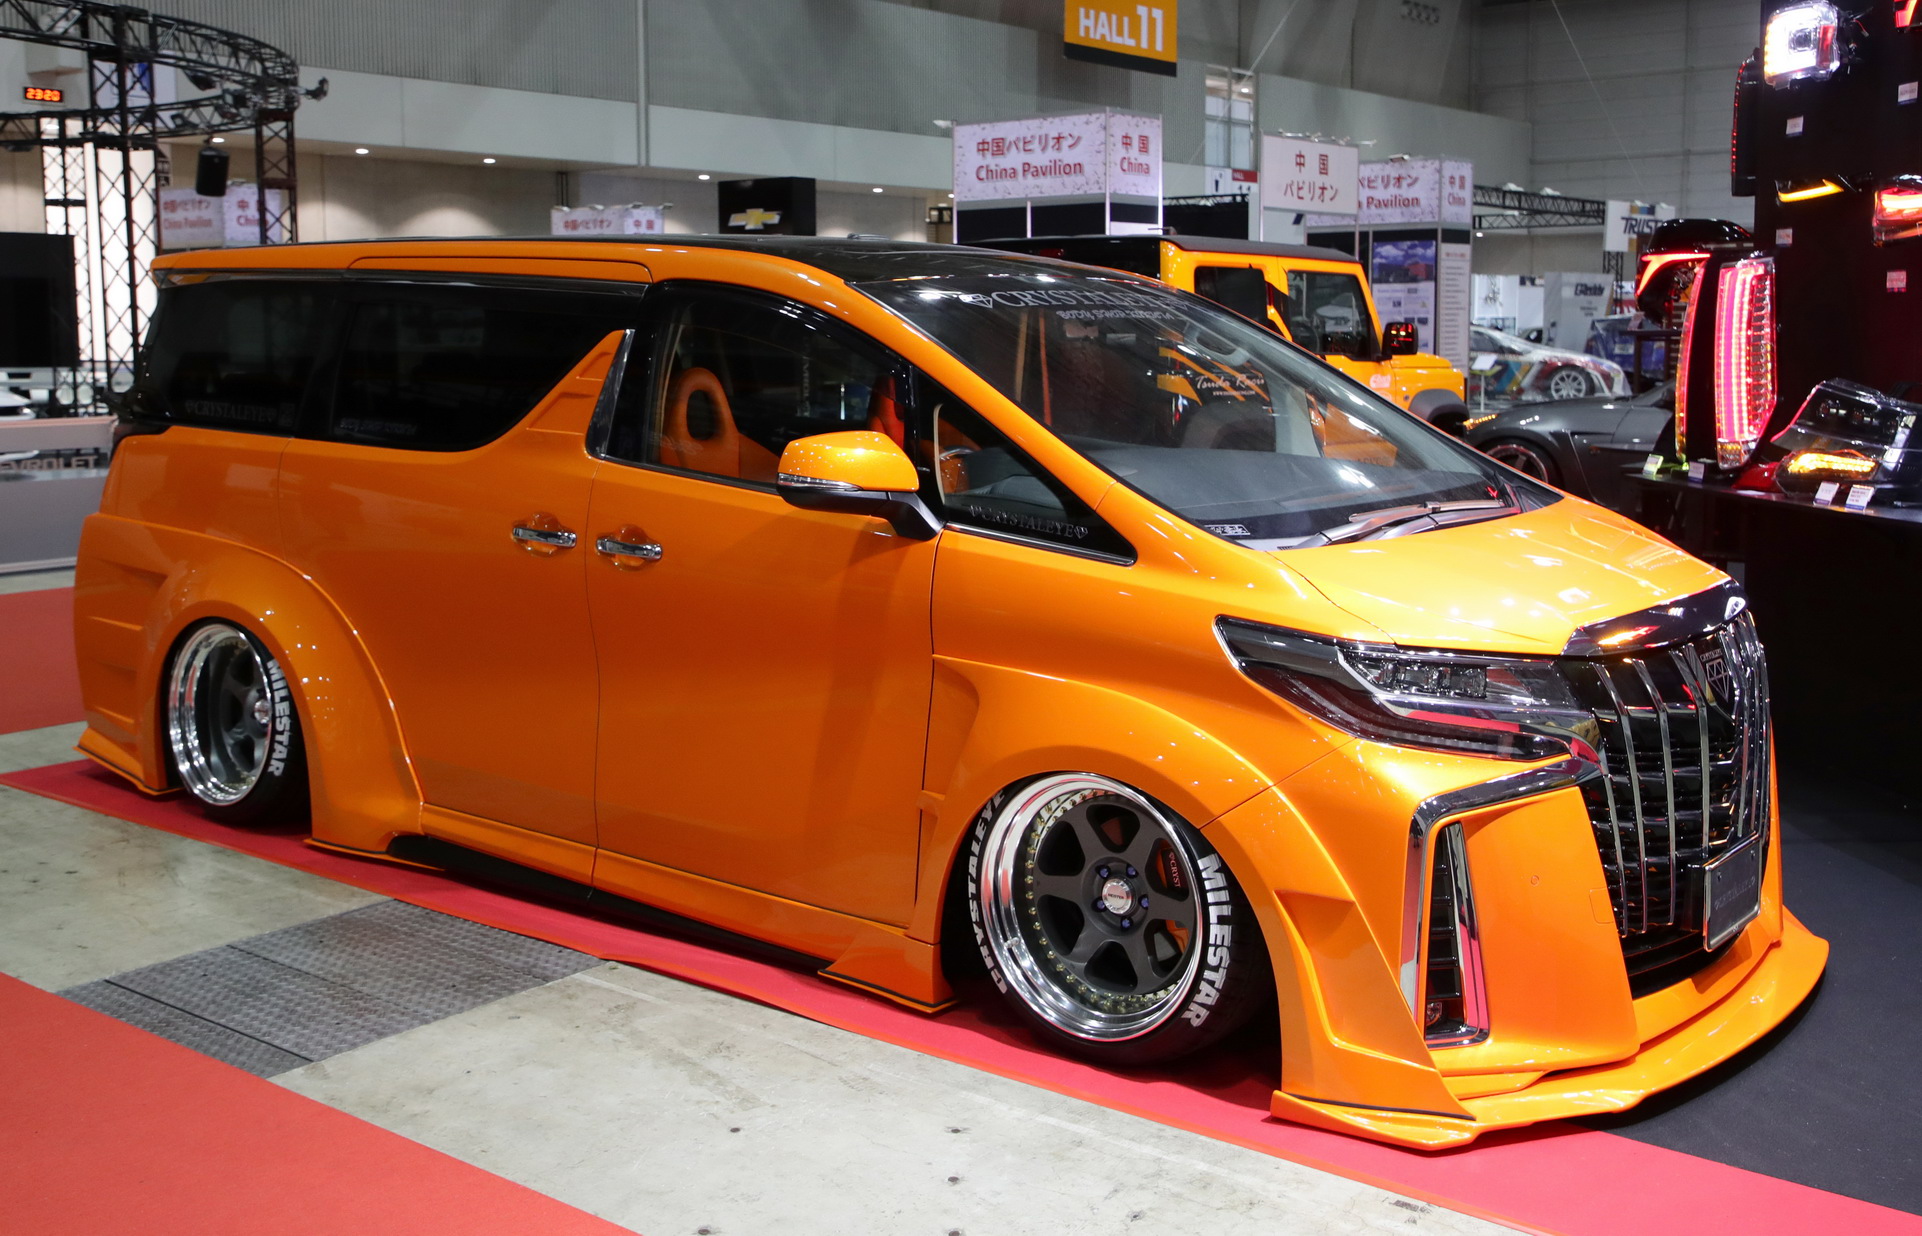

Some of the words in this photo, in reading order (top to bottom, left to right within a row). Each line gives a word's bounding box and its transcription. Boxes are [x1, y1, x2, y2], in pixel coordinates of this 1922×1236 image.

[1079, 7, 1136, 47] HALL
[1136, 4, 1164, 52] 11
[976, 132, 1083, 159] 中国パビリオン
[975, 164, 1018, 182] China
[1022, 159, 1084, 179] Pavilion
[1119, 156, 1150, 175] China
[1283, 180, 1339, 203] パビリオン
[1366, 194, 1421, 209] Pavilion
[981, 508, 1075, 538] CRYSTALEYE
[266, 658, 291, 777] MILESTAR
[968, 790, 1007, 994] CRYSTALEYE
[1181, 853, 1232, 1028] MILESTAR
